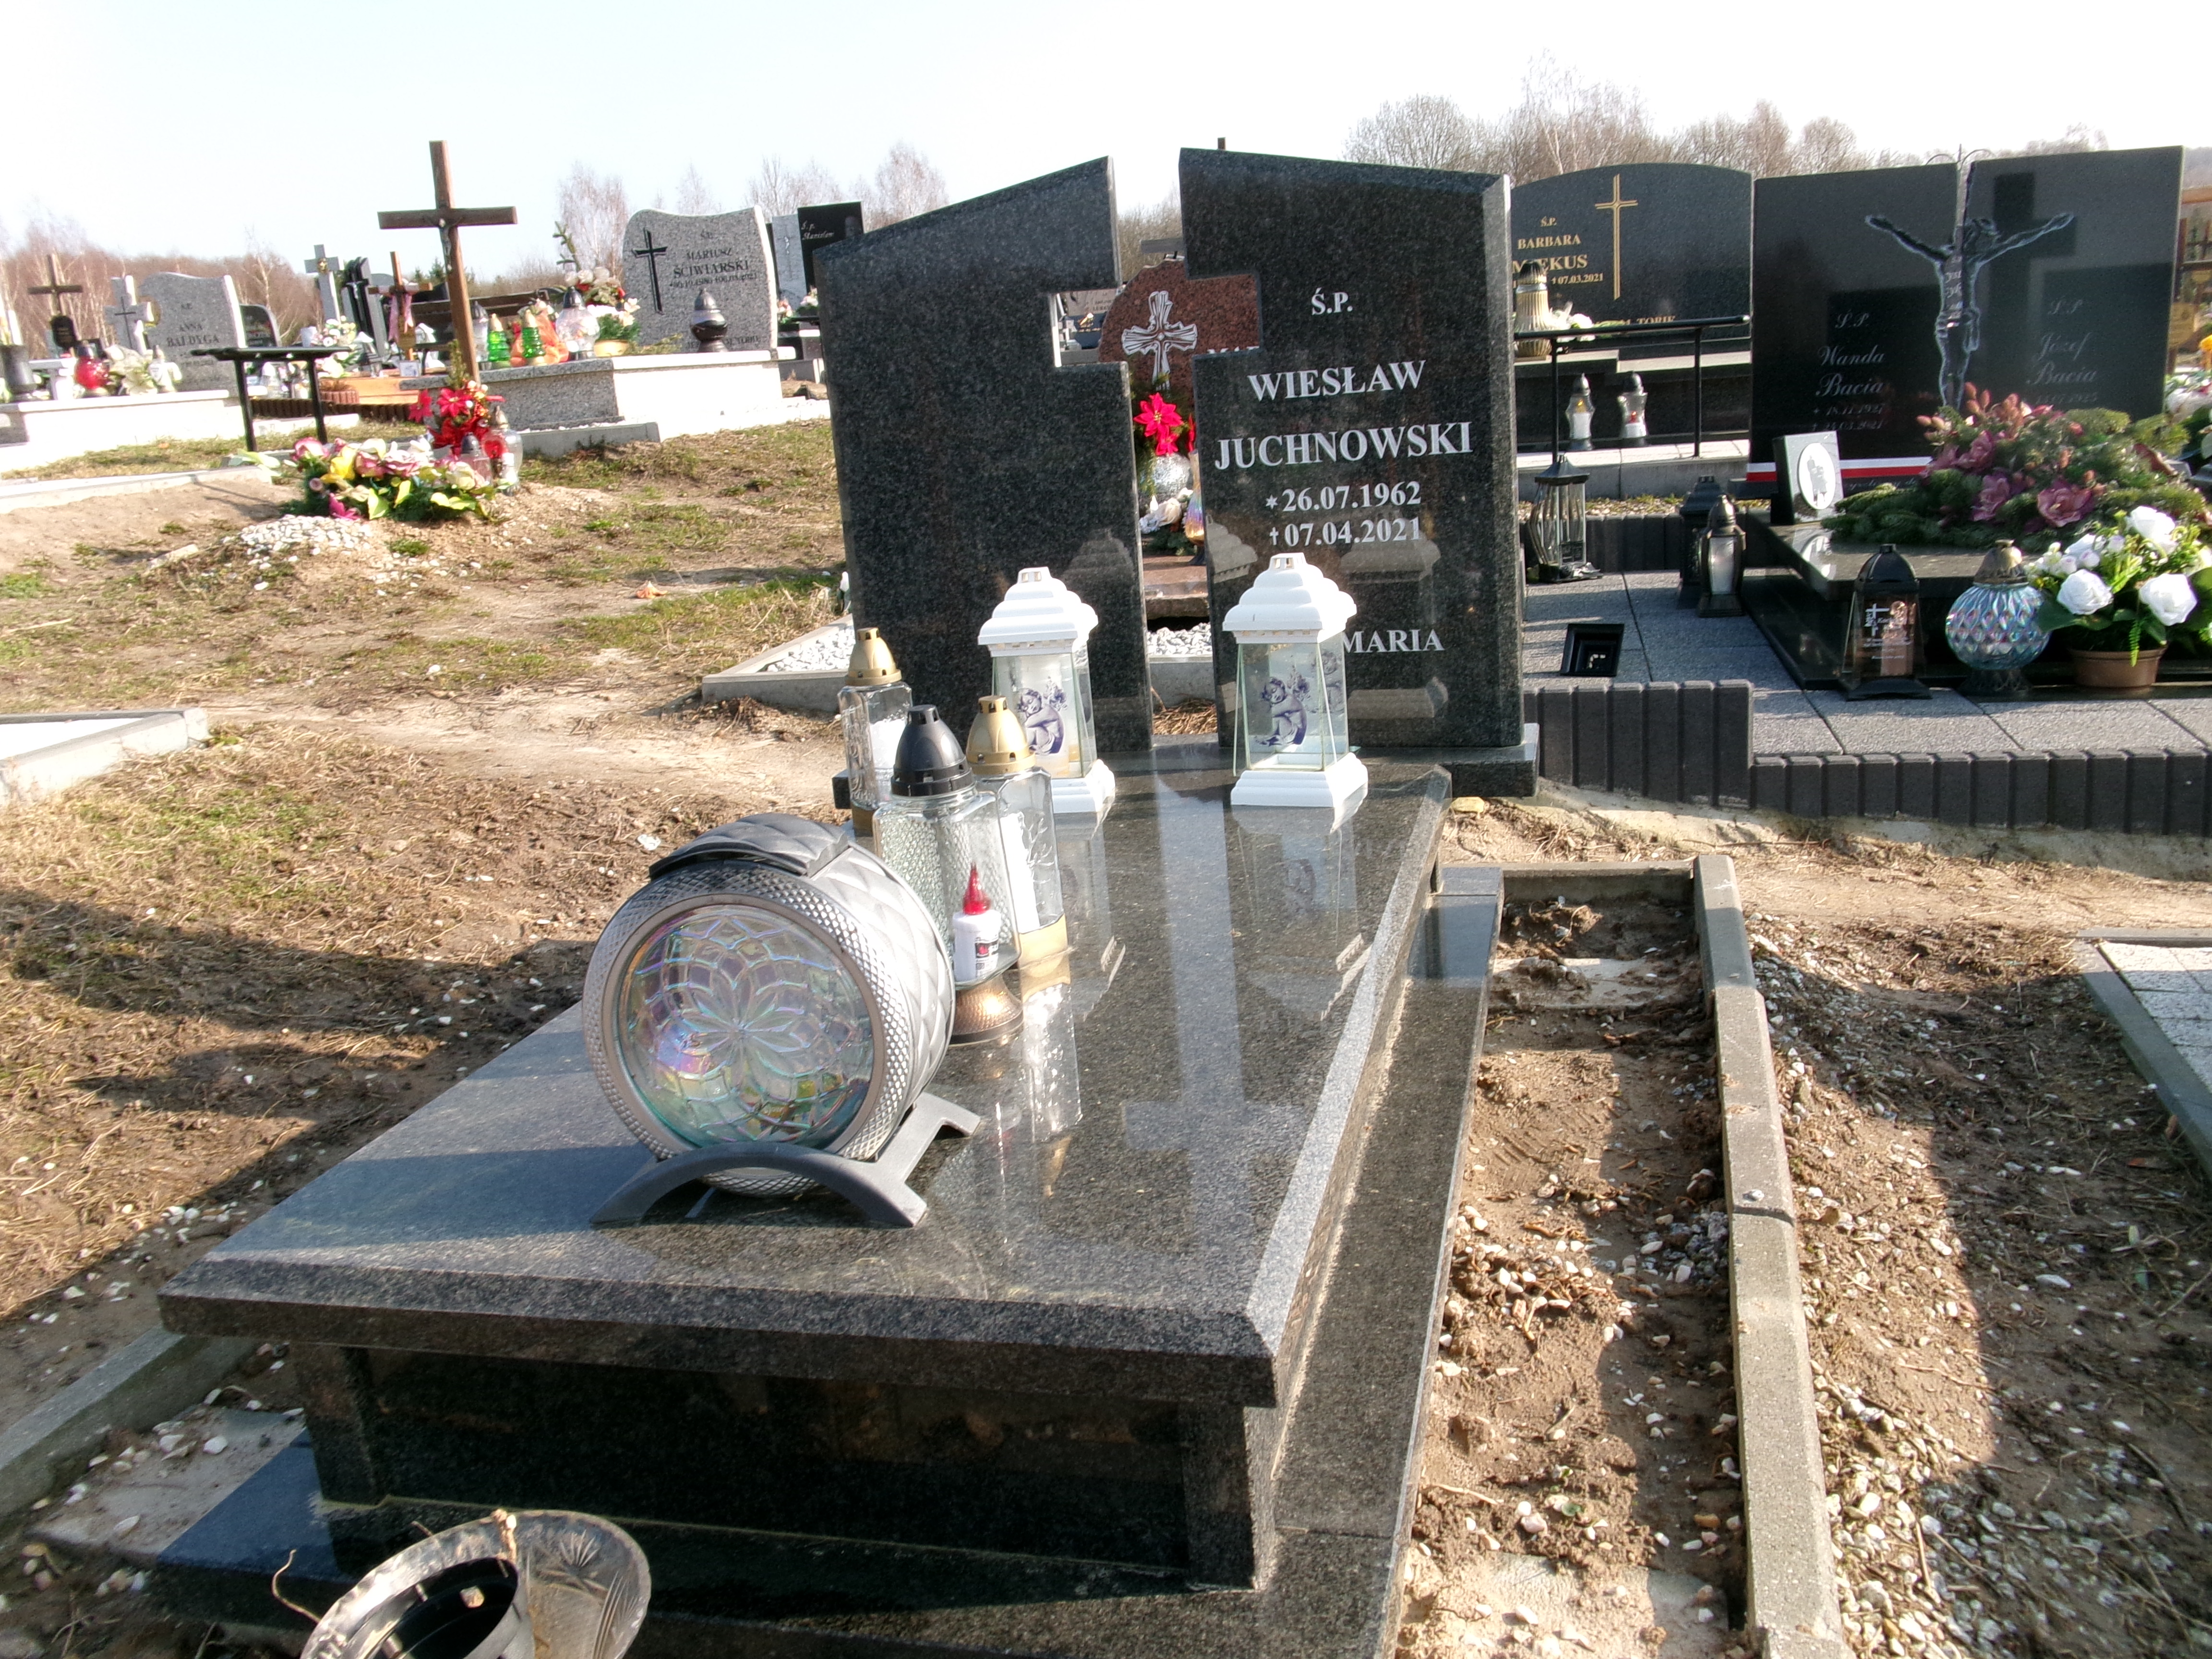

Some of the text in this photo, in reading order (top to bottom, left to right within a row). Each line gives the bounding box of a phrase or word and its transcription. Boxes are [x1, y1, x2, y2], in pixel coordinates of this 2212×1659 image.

[1517, 234, 1581, 250] BARBARA
[1557, 273, 1604, 285] 07.03.2021
[1310, 287, 1353, 315] Ś.P.
[1816, 344, 1886, 366] Wanda
[1247, 360, 1426, 402] WIESŁAW
[1815, 373, 1884, 397] Bacia
[1214, 421, 1474, 470] JUCHNOWSKI
[1343, 628, 1445, 653] MARIA
